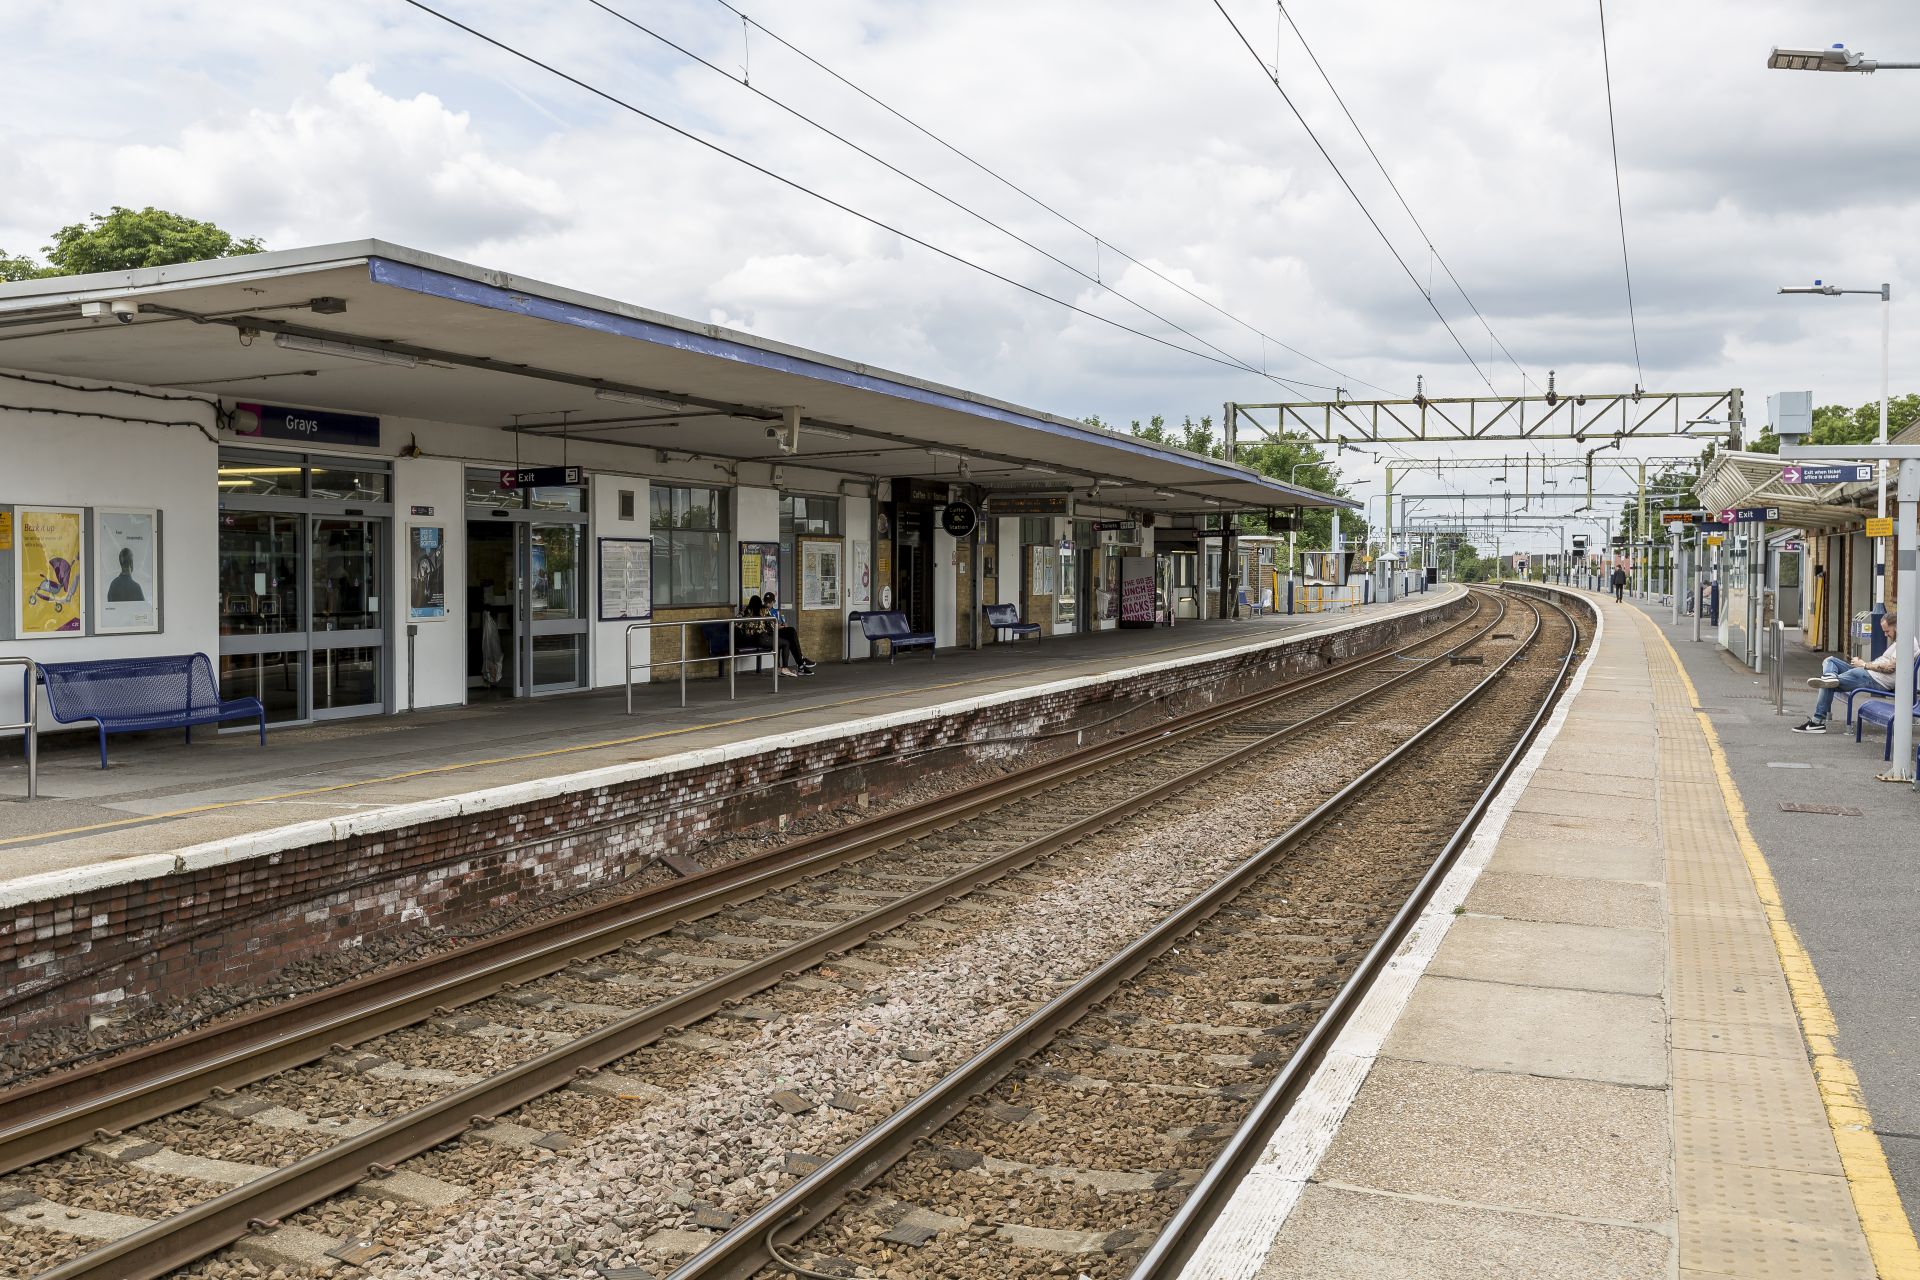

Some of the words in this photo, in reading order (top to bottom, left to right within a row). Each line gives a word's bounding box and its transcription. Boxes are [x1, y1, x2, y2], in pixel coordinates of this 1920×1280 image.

[286, 415, 318, 434] Grays
[518, 473, 535, 482] Exit
[1738, 510, 1754, 518] Exit
[1122, 600, 1150, 615] NACKS
